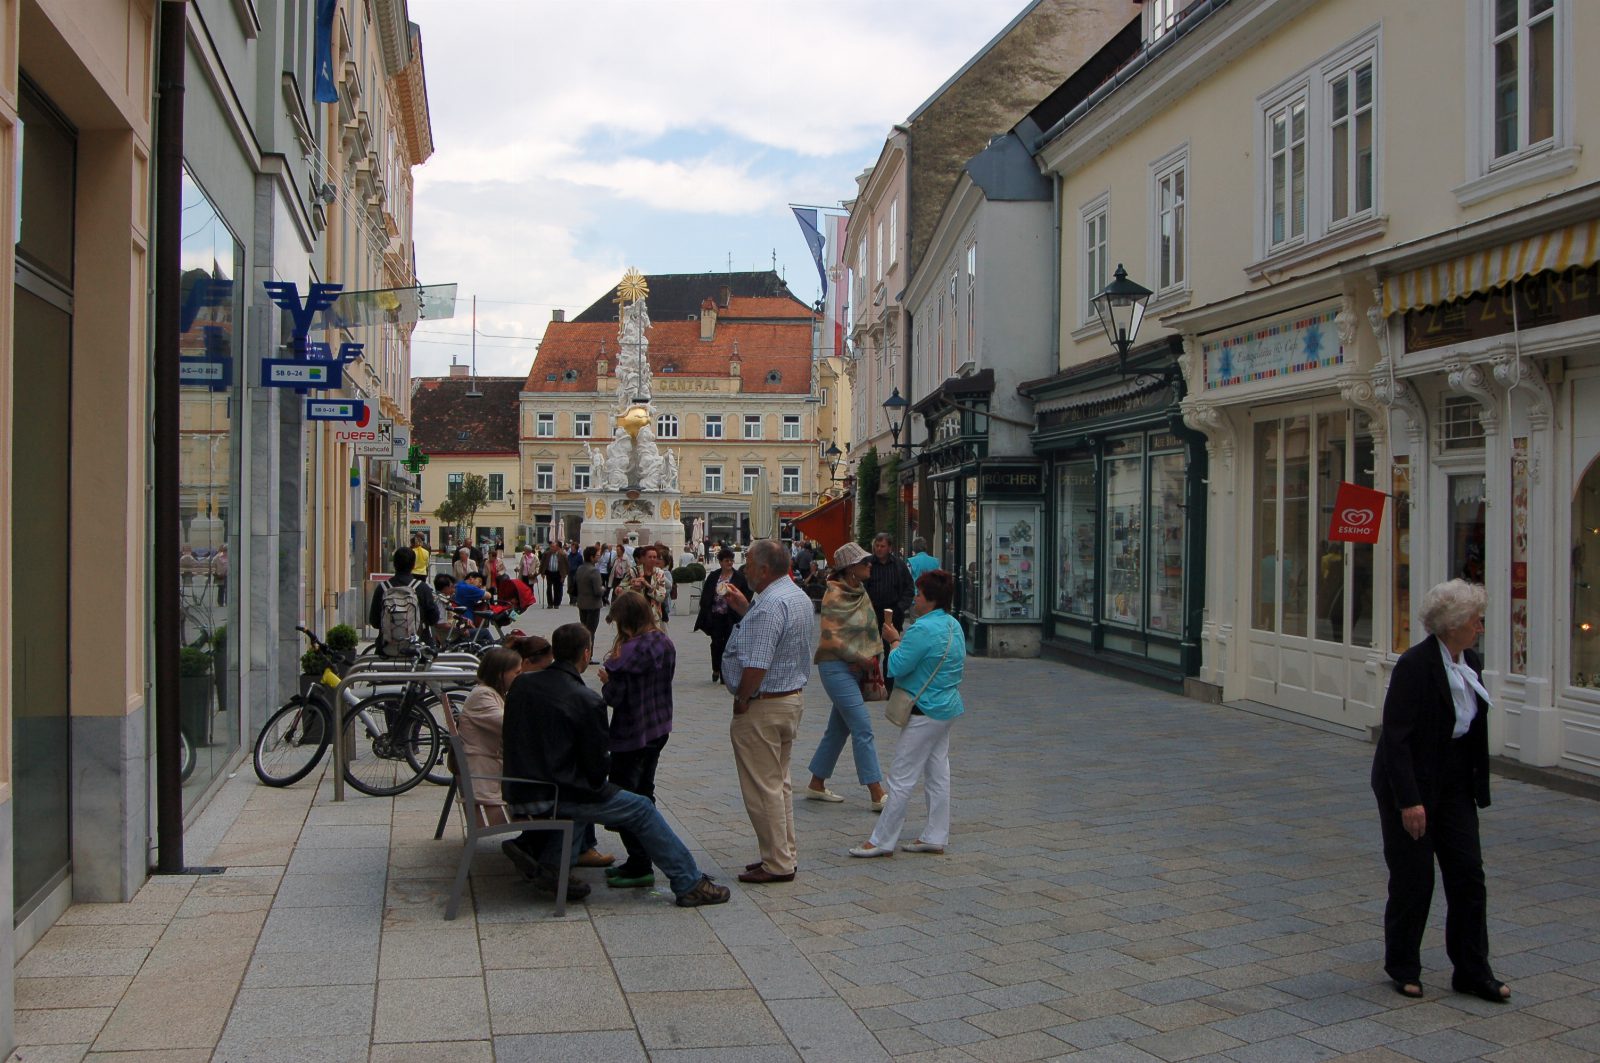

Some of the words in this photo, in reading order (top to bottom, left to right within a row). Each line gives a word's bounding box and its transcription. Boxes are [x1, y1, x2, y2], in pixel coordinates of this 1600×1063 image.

[1480, 265, 1600, 321] ZUCKE
[660, 379, 719, 392] CENTRAL
[336, 431, 375, 441] ruefa
[984, 471, 1038, 486] BÜCHER
[1338, 526, 1371, 535] ESKIMO
